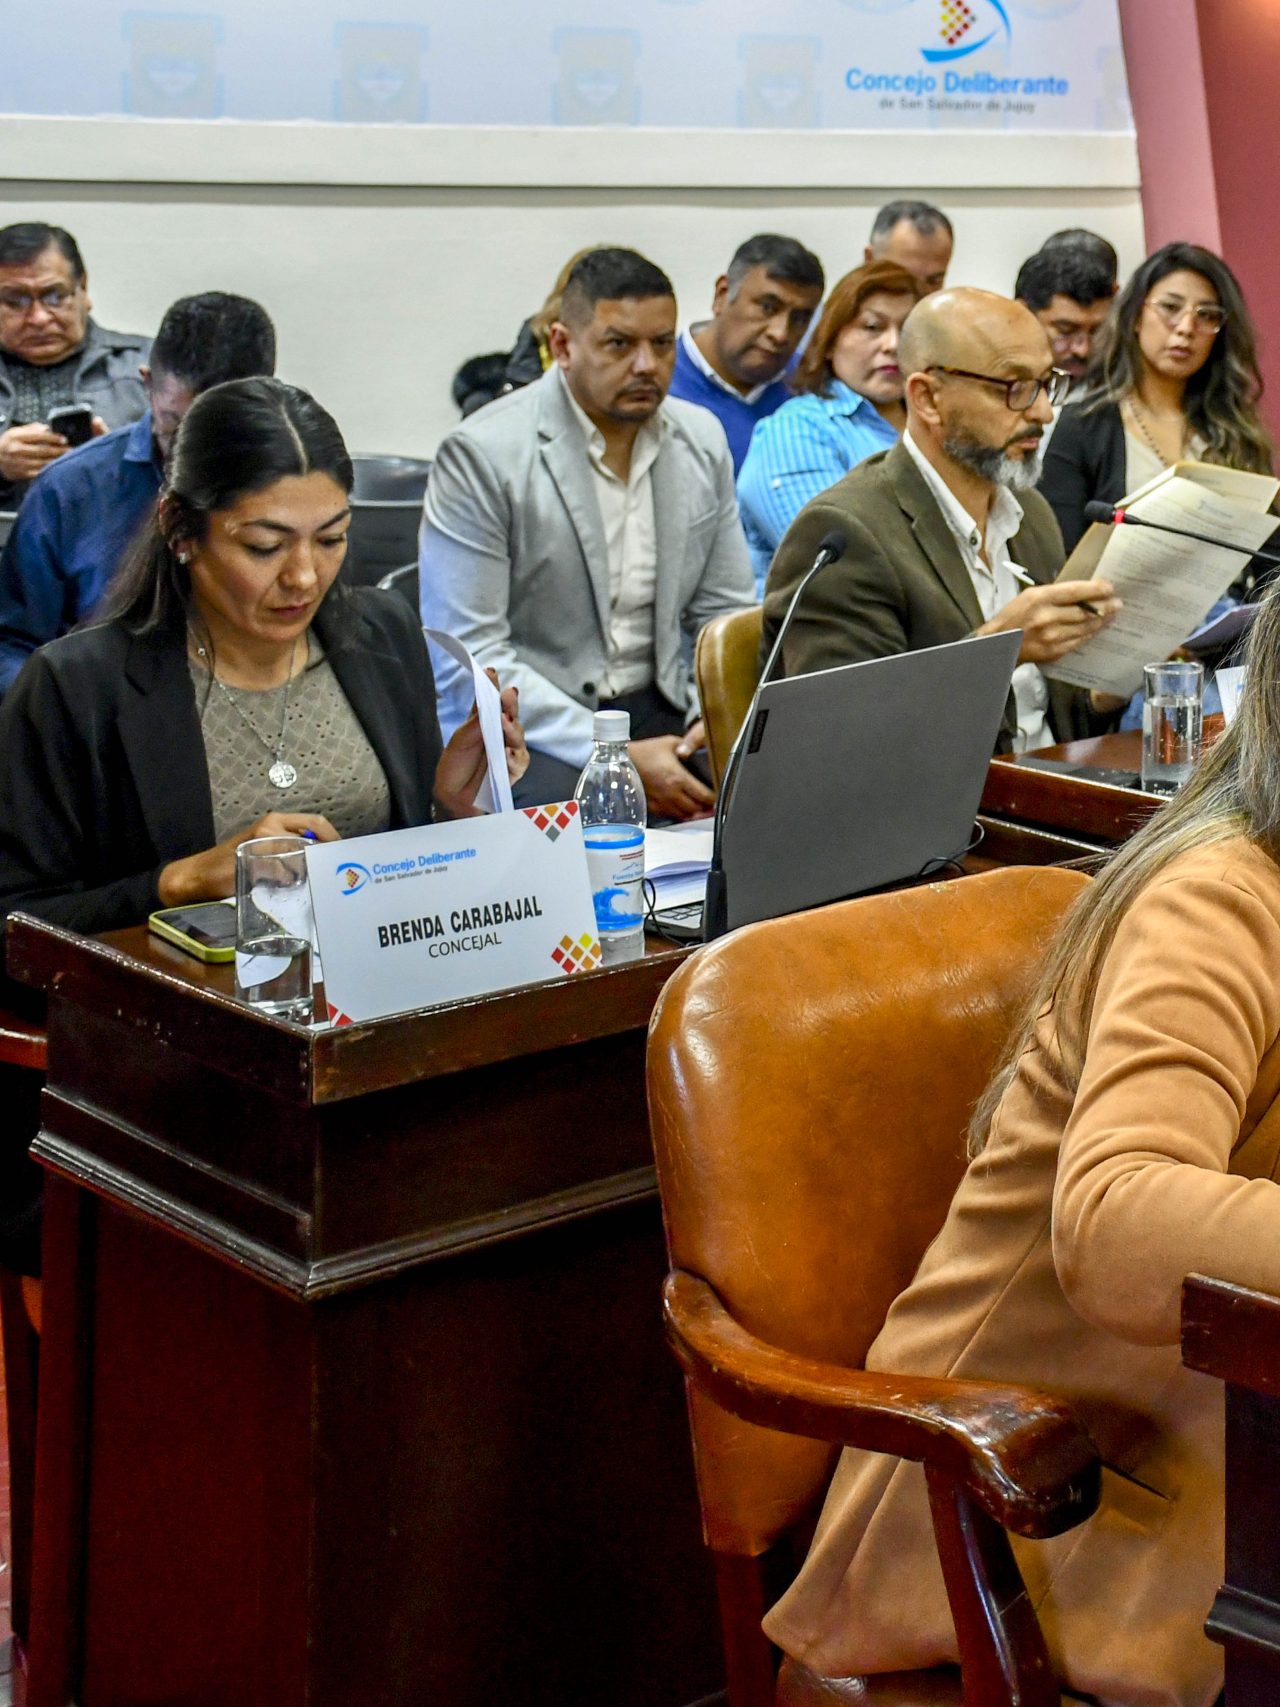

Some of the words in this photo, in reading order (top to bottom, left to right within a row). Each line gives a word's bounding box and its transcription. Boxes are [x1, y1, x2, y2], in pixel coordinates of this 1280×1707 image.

[845, 68, 937, 96] Concejo
[943, 70, 1069, 96] Deliberante
[879, 98, 894, 110] de
[900, 98, 921, 110] San
[927, 99, 982, 112] Salvador
[986, 100, 1000, 112] de
[1003, 101, 1037, 115] Jujuy
[372, 858, 416, 876] Concejo
[418, 848, 477, 867] Deliberante
[384, 874, 396, 883] San
[397, 870, 424, 880] Salvador
[425, 867, 433, 875] de
[377, 915, 445, 948] BRENDA
[450, 896, 543, 933] CARABAJAL
[428, 932, 503, 958] CONCEJAL
